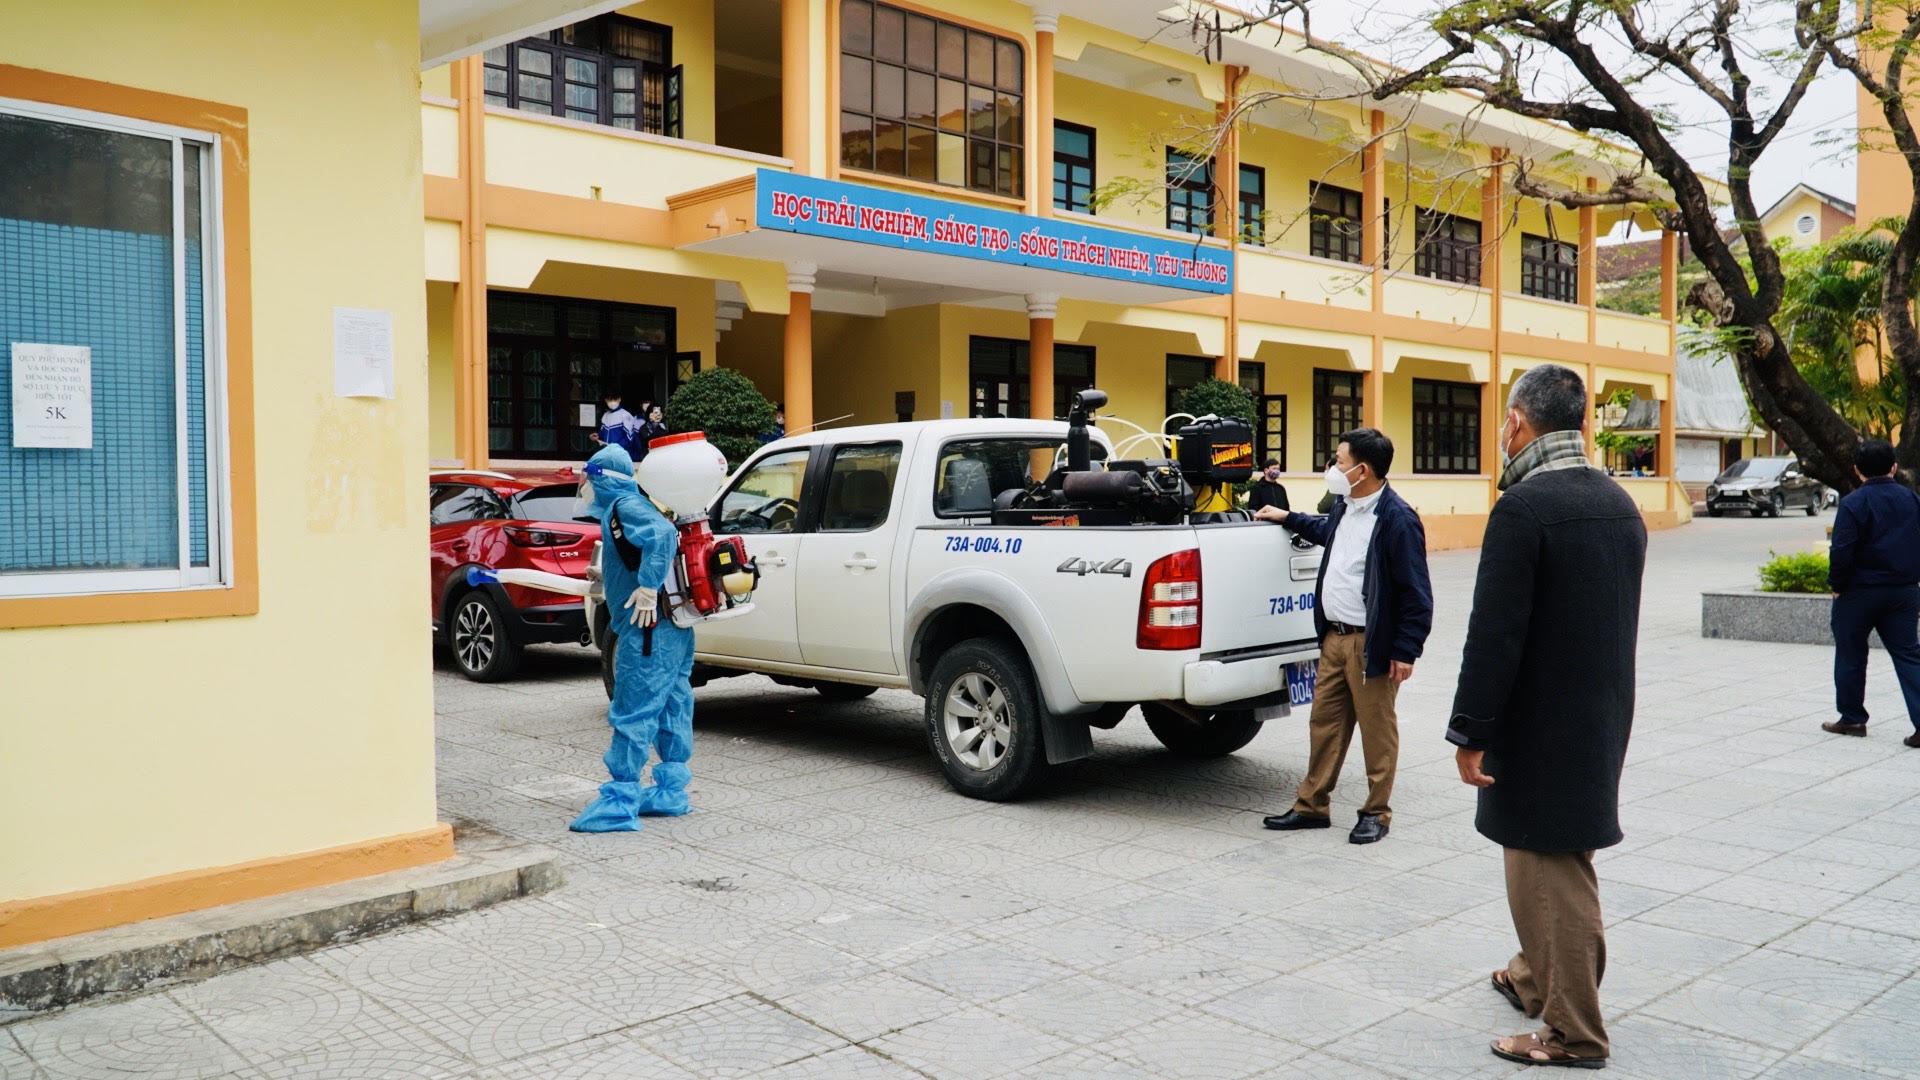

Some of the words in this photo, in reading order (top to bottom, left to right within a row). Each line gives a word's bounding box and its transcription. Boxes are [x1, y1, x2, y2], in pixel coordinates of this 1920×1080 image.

[772, 191, 812, 225] HỌC
[816, 195, 856, 229] TRẢI
[859, 207, 930, 243] NGHIỆM,
[934, 214, 977, 247] SÁNG
[981, 226, 1009, 255] TẠO
[1019, 226, 1059, 258] SỐNG
[1062, 236, 1106, 266] TRÁCH
[1109, 246, 1152, 276] NHIỆM,
[1155, 251, 1179, 276] YÊU
[45, 406, 67, 420] 5K
[944, 536, 1023, 554] 73A-004.10
[1056, 556, 1132, 578] 4x4
[1269, 592, 1316, 615] 73A-00
[1290, 681, 1316, 704] 004
